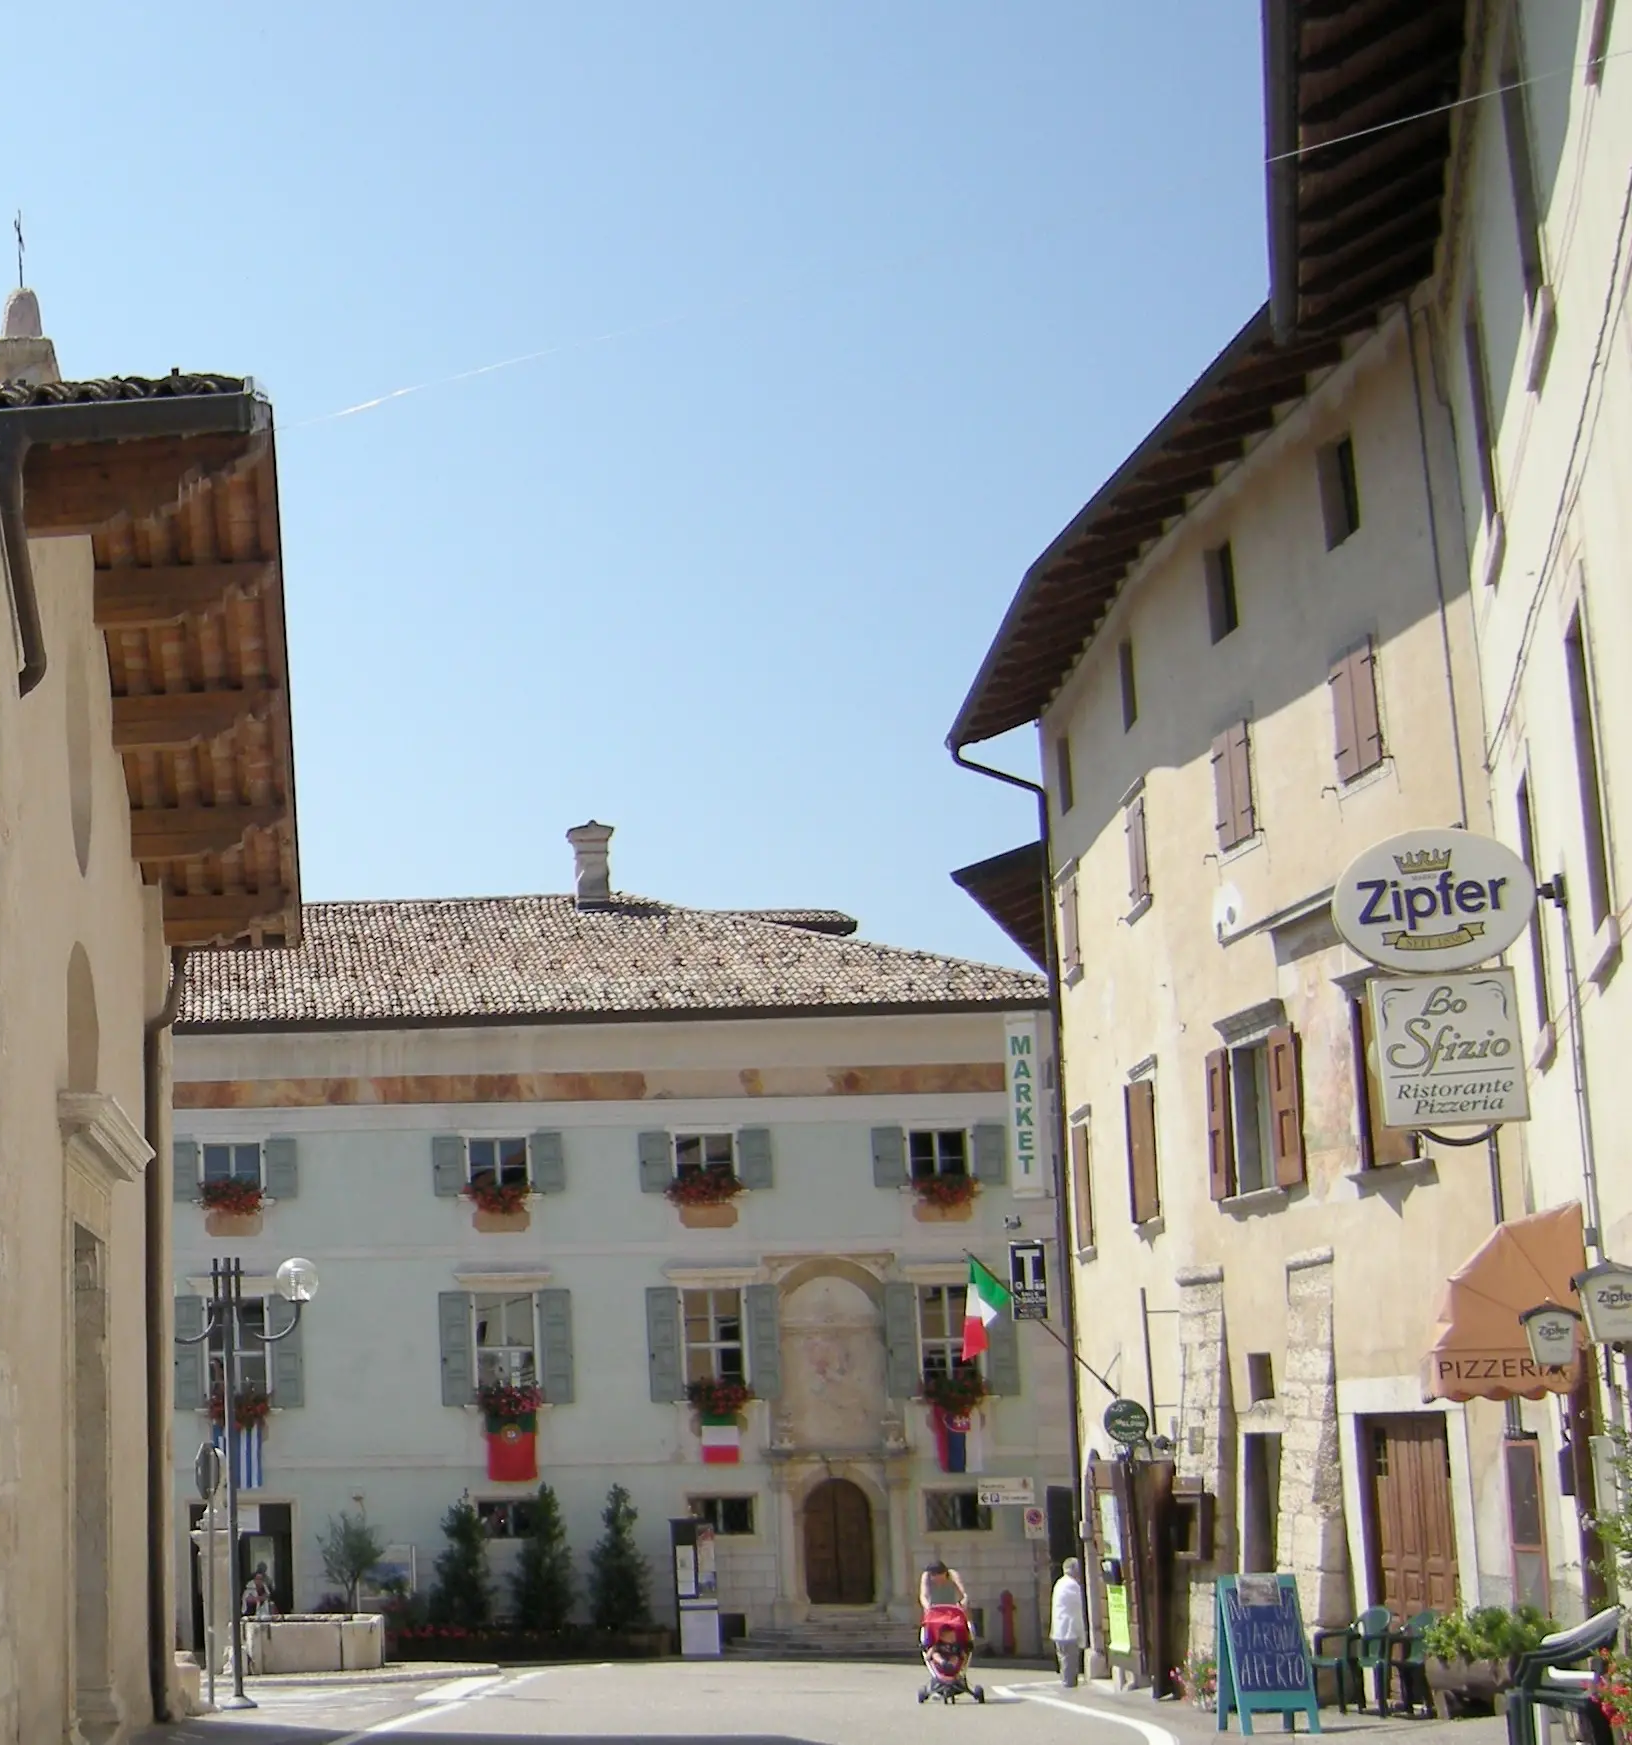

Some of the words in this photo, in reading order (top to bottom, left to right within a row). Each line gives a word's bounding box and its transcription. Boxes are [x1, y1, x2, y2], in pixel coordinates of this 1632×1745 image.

[1356, 870, 1507, 930] Zipfer
[1386, 1017, 1512, 1077] Sfizio
[1010, 1035, 1035, 1175] MARKET
[1396, 1079, 1514, 1101] Ristorante
[1414, 1095, 1505, 1116] Pizzeria
[1015, 1248, 1040, 1290] T
[1597, 1289, 1632, 1305] Zipfe
[1538, 1323, 1570, 1337] Zipfer
[1241, 1651, 1305, 1687] APERTO
